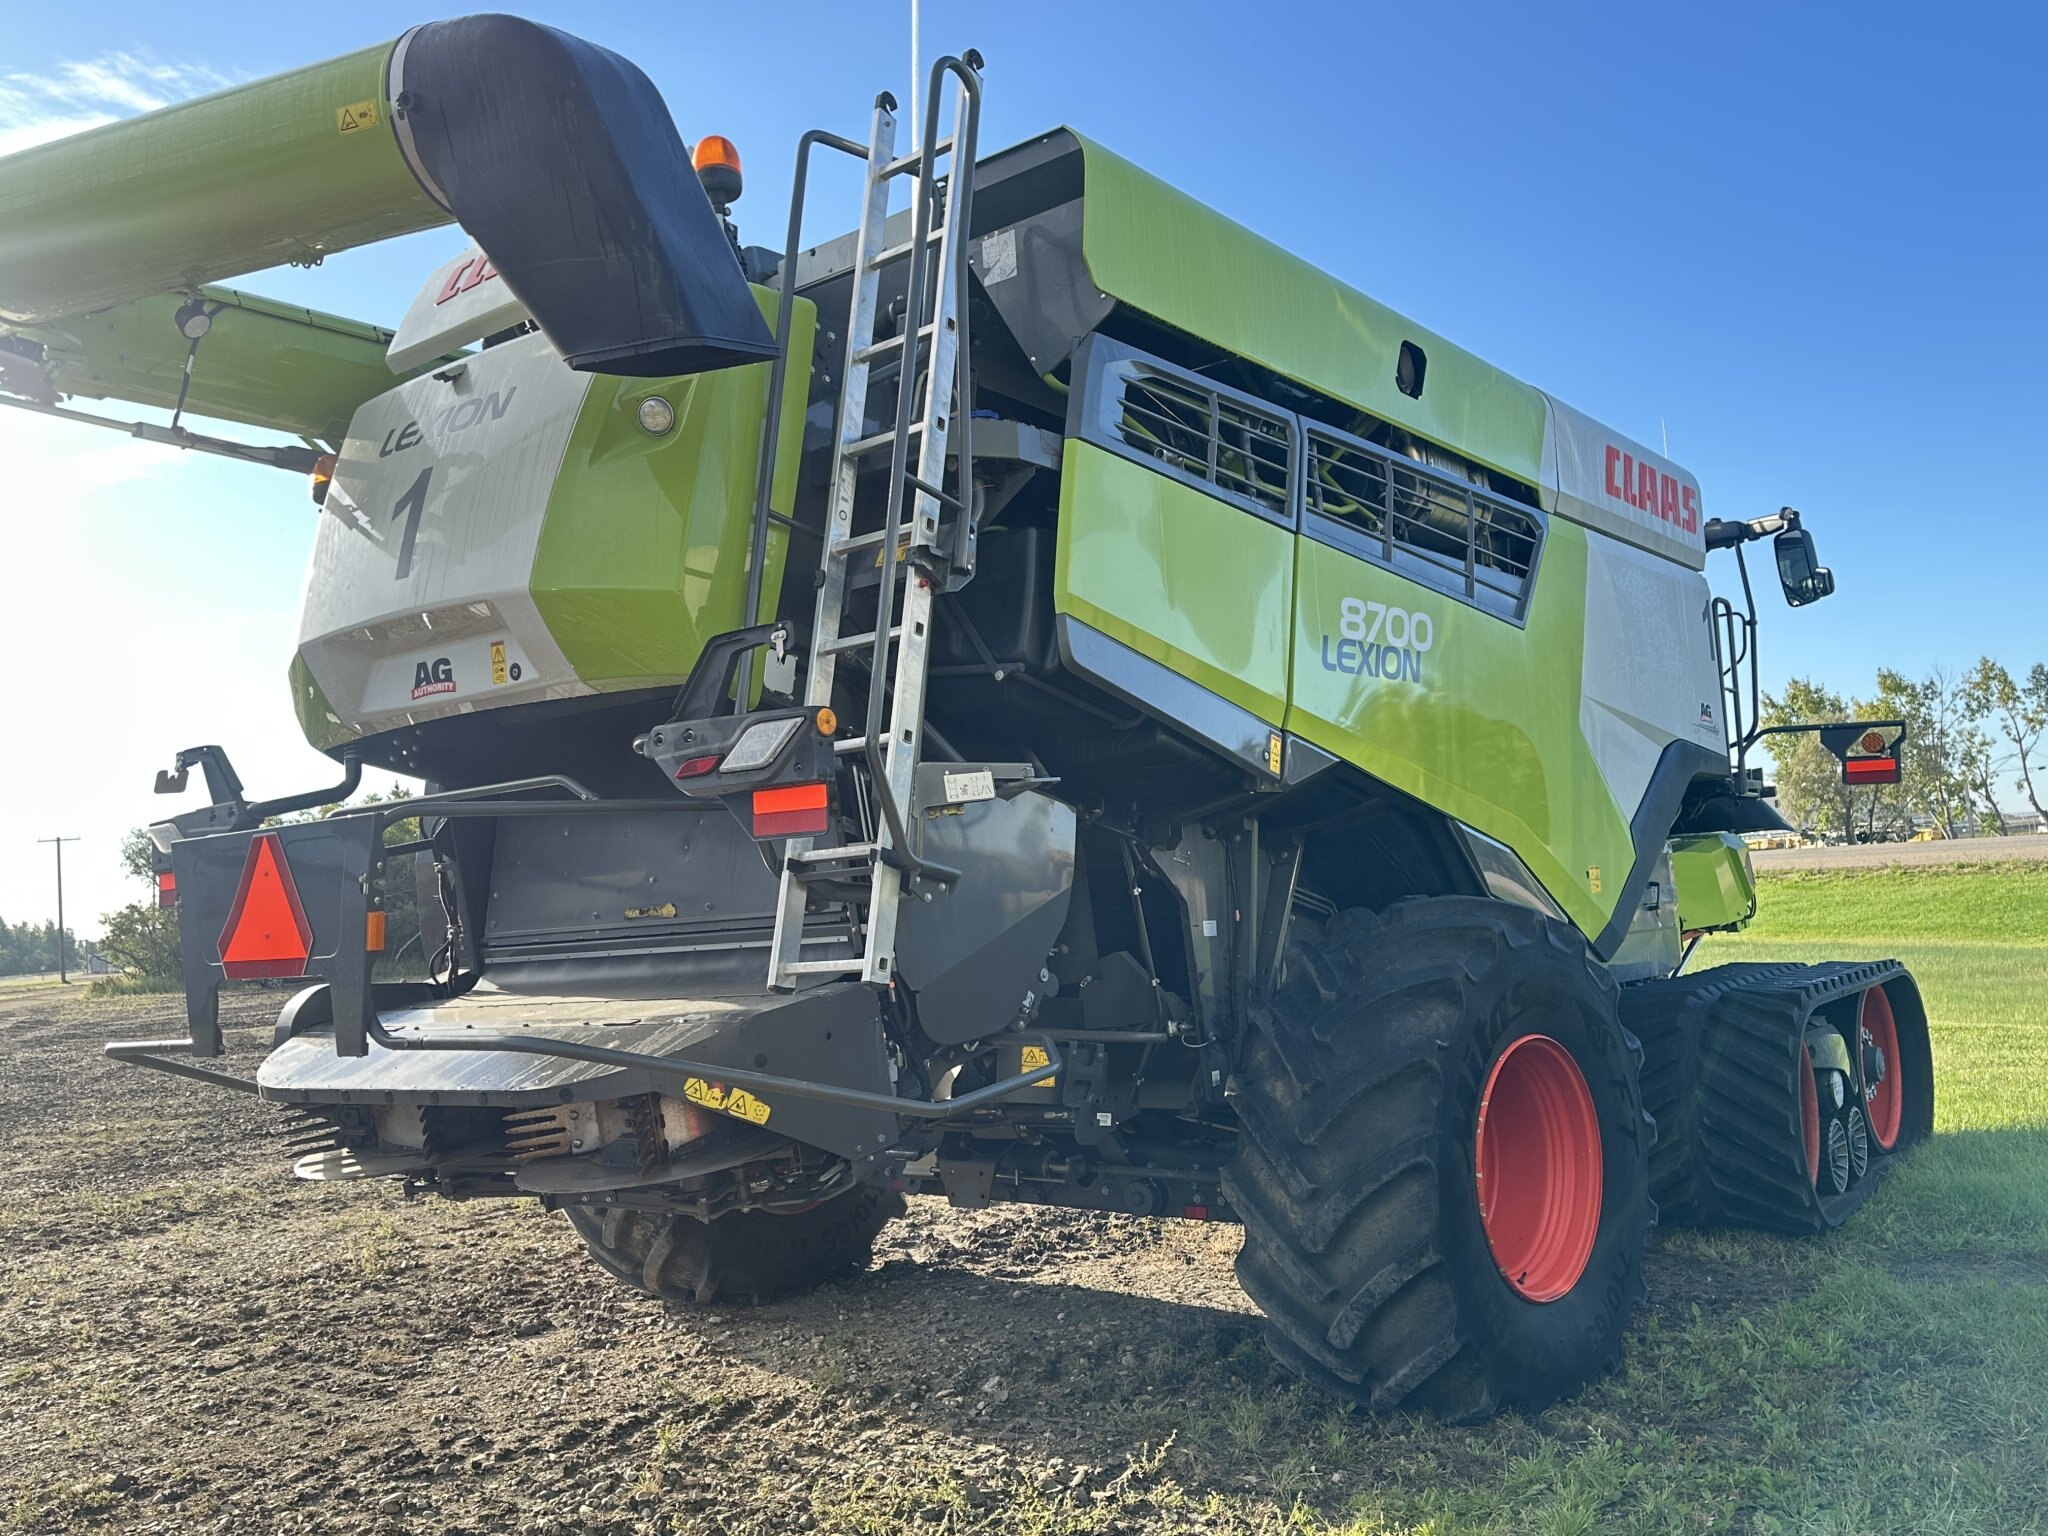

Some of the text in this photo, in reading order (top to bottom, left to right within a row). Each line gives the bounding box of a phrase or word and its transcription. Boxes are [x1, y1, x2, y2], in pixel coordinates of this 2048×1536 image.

[379, 386, 517, 458] LEXION
[1605, 444, 1696, 534] CLAAS
[391, 466, 434, 580] 1
[1340, 597, 1433, 652] 8700
[1702, 599, 1716, 661] 1
[414, 657, 453, 689] AG
[1321, 634, 1421, 684] LEXION
[413, 682, 454, 698] AUTHORITY
